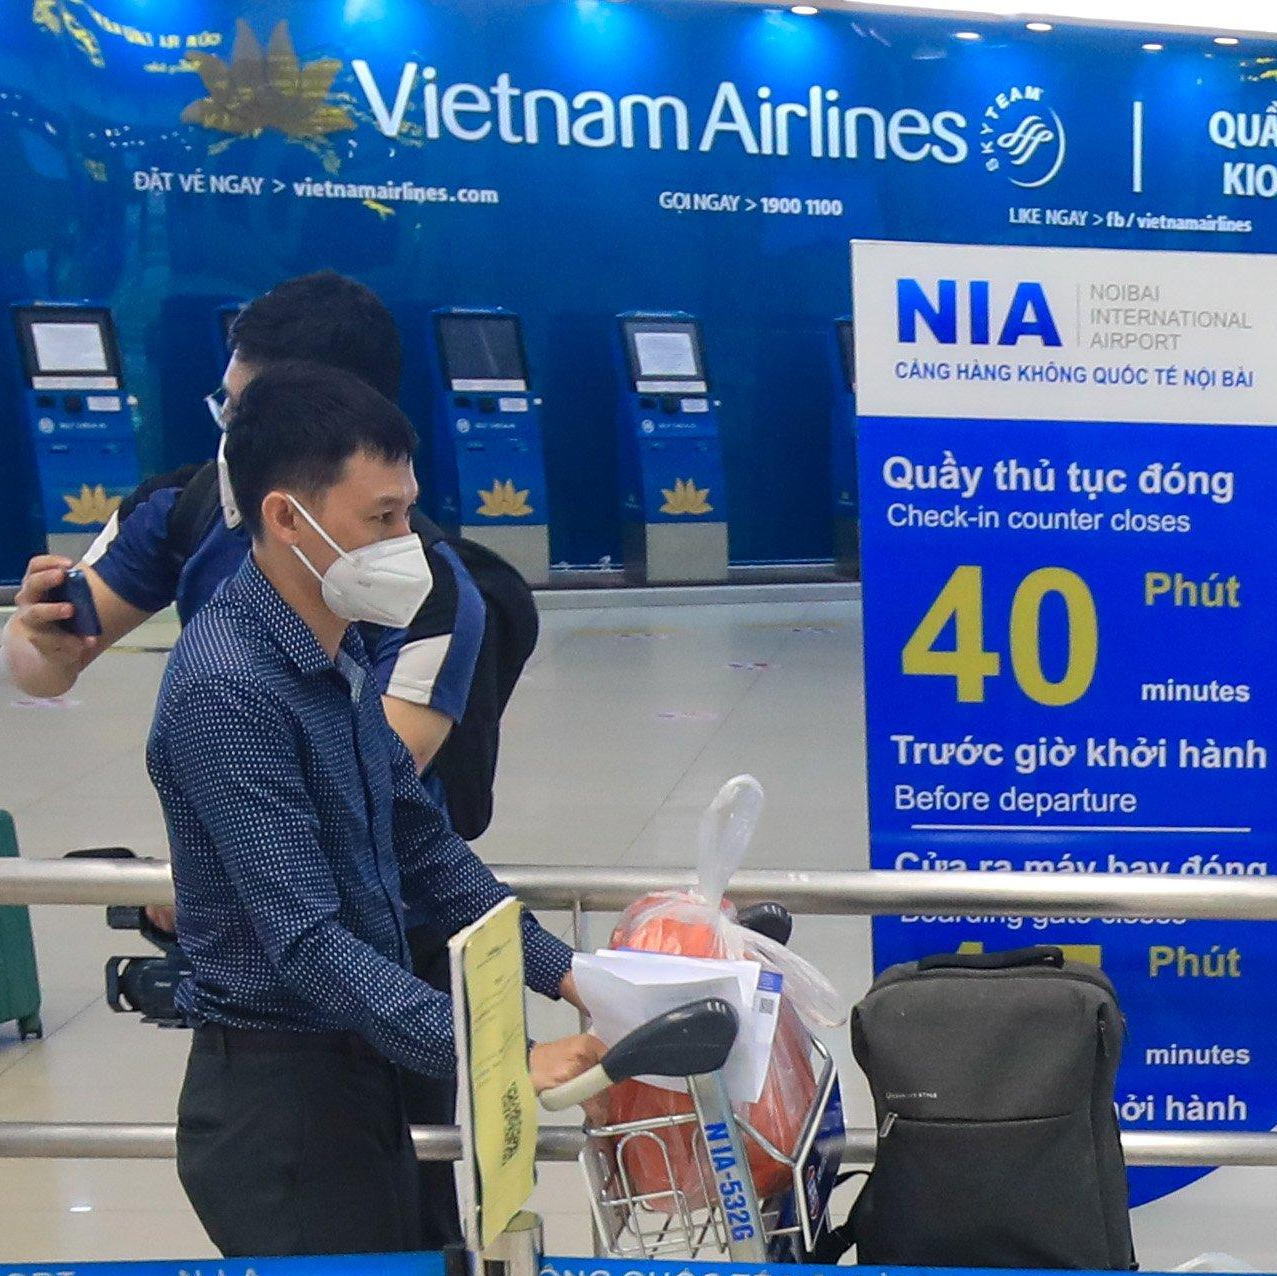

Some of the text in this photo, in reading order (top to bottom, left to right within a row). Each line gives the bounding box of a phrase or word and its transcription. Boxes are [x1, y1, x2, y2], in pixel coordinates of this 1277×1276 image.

[350, 58, 969, 164] Vietnam Airlines
[210, 174, 265, 195] NGAY
[292, 177, 499, 203] vietnamairlines.com
[693, 194, 740, 212] NGAY
[760, 197, 803, 214] 1900
[805, 199, 843, 216] 1100
[1009, 207, 1042, 224] LIKE
[1045, 208, 1089, 226] NGAY
[1089, 283, 1161, 303] NOIBAI
[896, 277, 1063, 348] NIA
[1089, 307, 1253, 330] INTERNATIONAL
[1089, 331, 1182, 351] AIRPORT
[894, 359, 1254, 389] CẢNG HÀNG KHÔNG QUỐC TẾ NỘI BÀI
[882, 450, 1235, 503] Quầy thủ tục đóng
[887, 503, 1192, 533] Check-in counter closes
[1144, 571, 1241, 608] Phút
[901, 564, 1098, 707] 40
[1141, 680, 1251, 703] minutes
[890, 735, 1268, 774] Trước giờ khởi hành
[894, 785, 1138, 817] Before departure
[1149, 945, 1241, 978] Phút
[1145, 1045, 1251, 1067] minutes
[1164, 1097, 1248, 1122] hành
